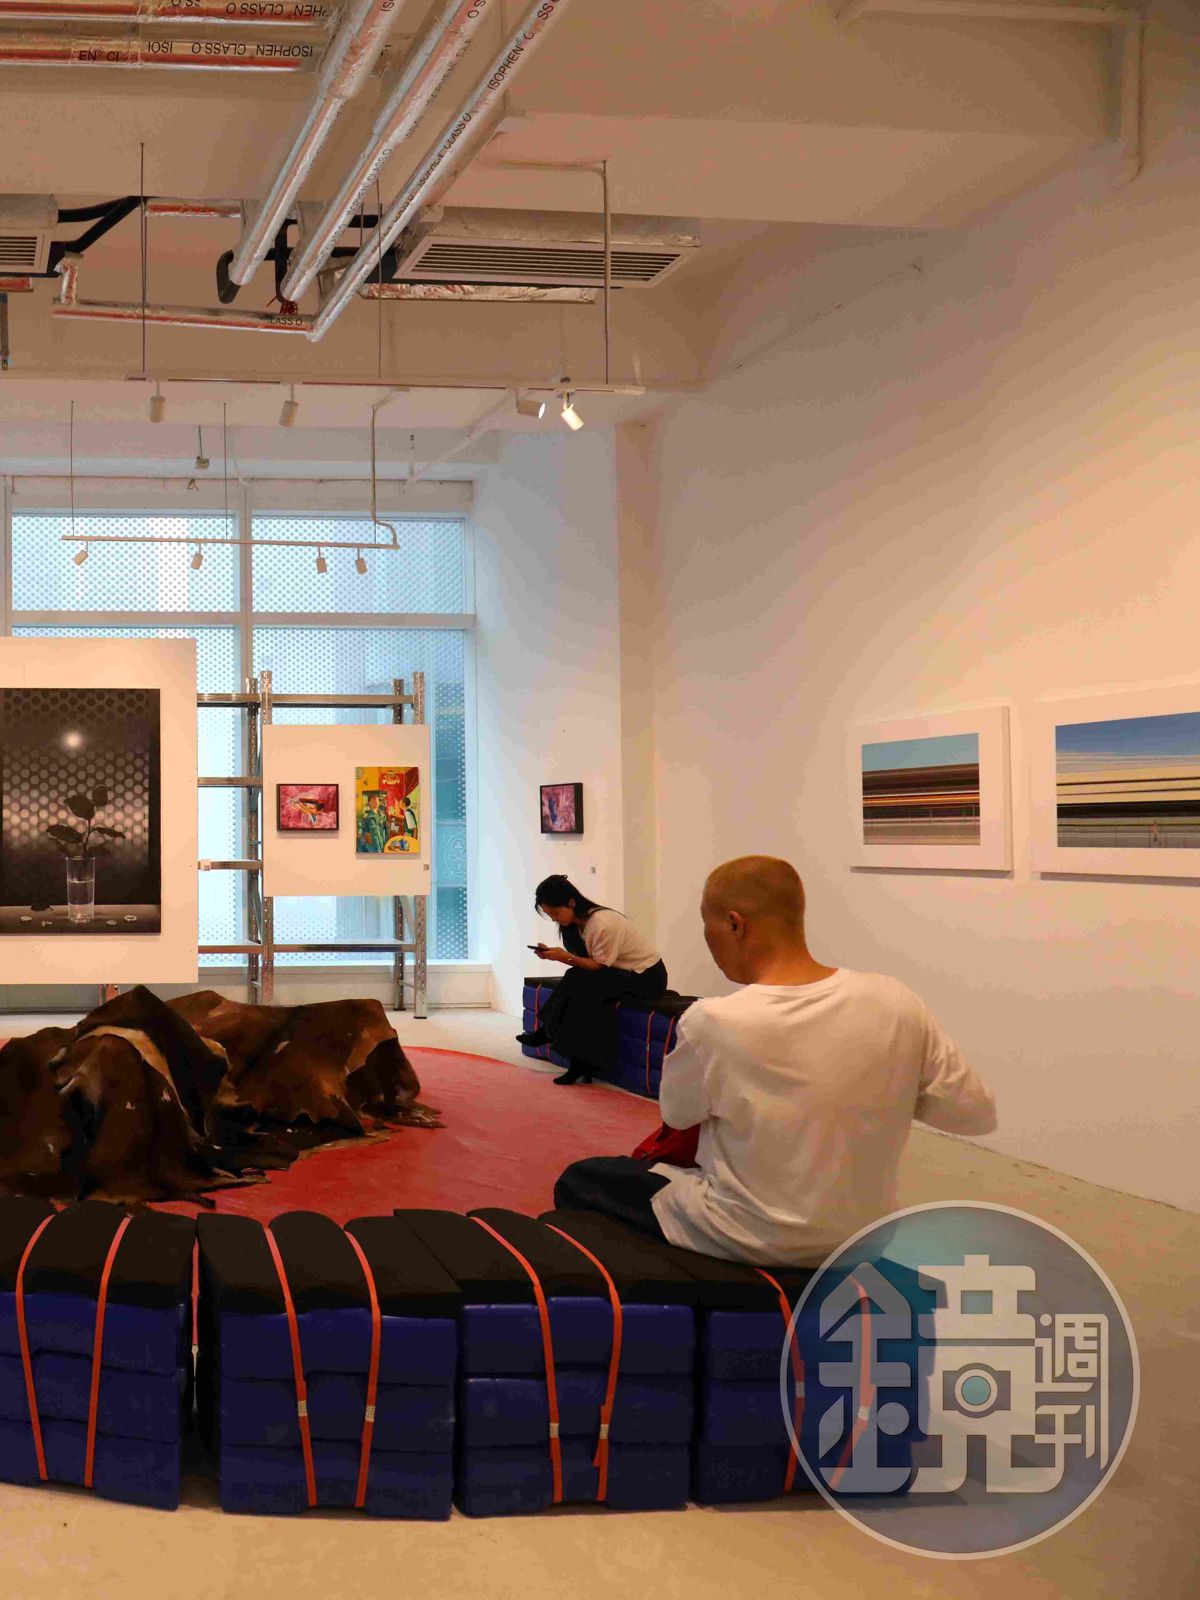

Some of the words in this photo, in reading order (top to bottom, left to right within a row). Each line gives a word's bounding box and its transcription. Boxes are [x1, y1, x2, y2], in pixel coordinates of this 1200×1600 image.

[240, 3, 284, 16] CLASS
[205, 43, 247, 56] CLASS
[256, 44, 314, 58] ISOPHEN
[443, 121, 467, 150] CLASS
[267, 316, 293, 326] LASS
